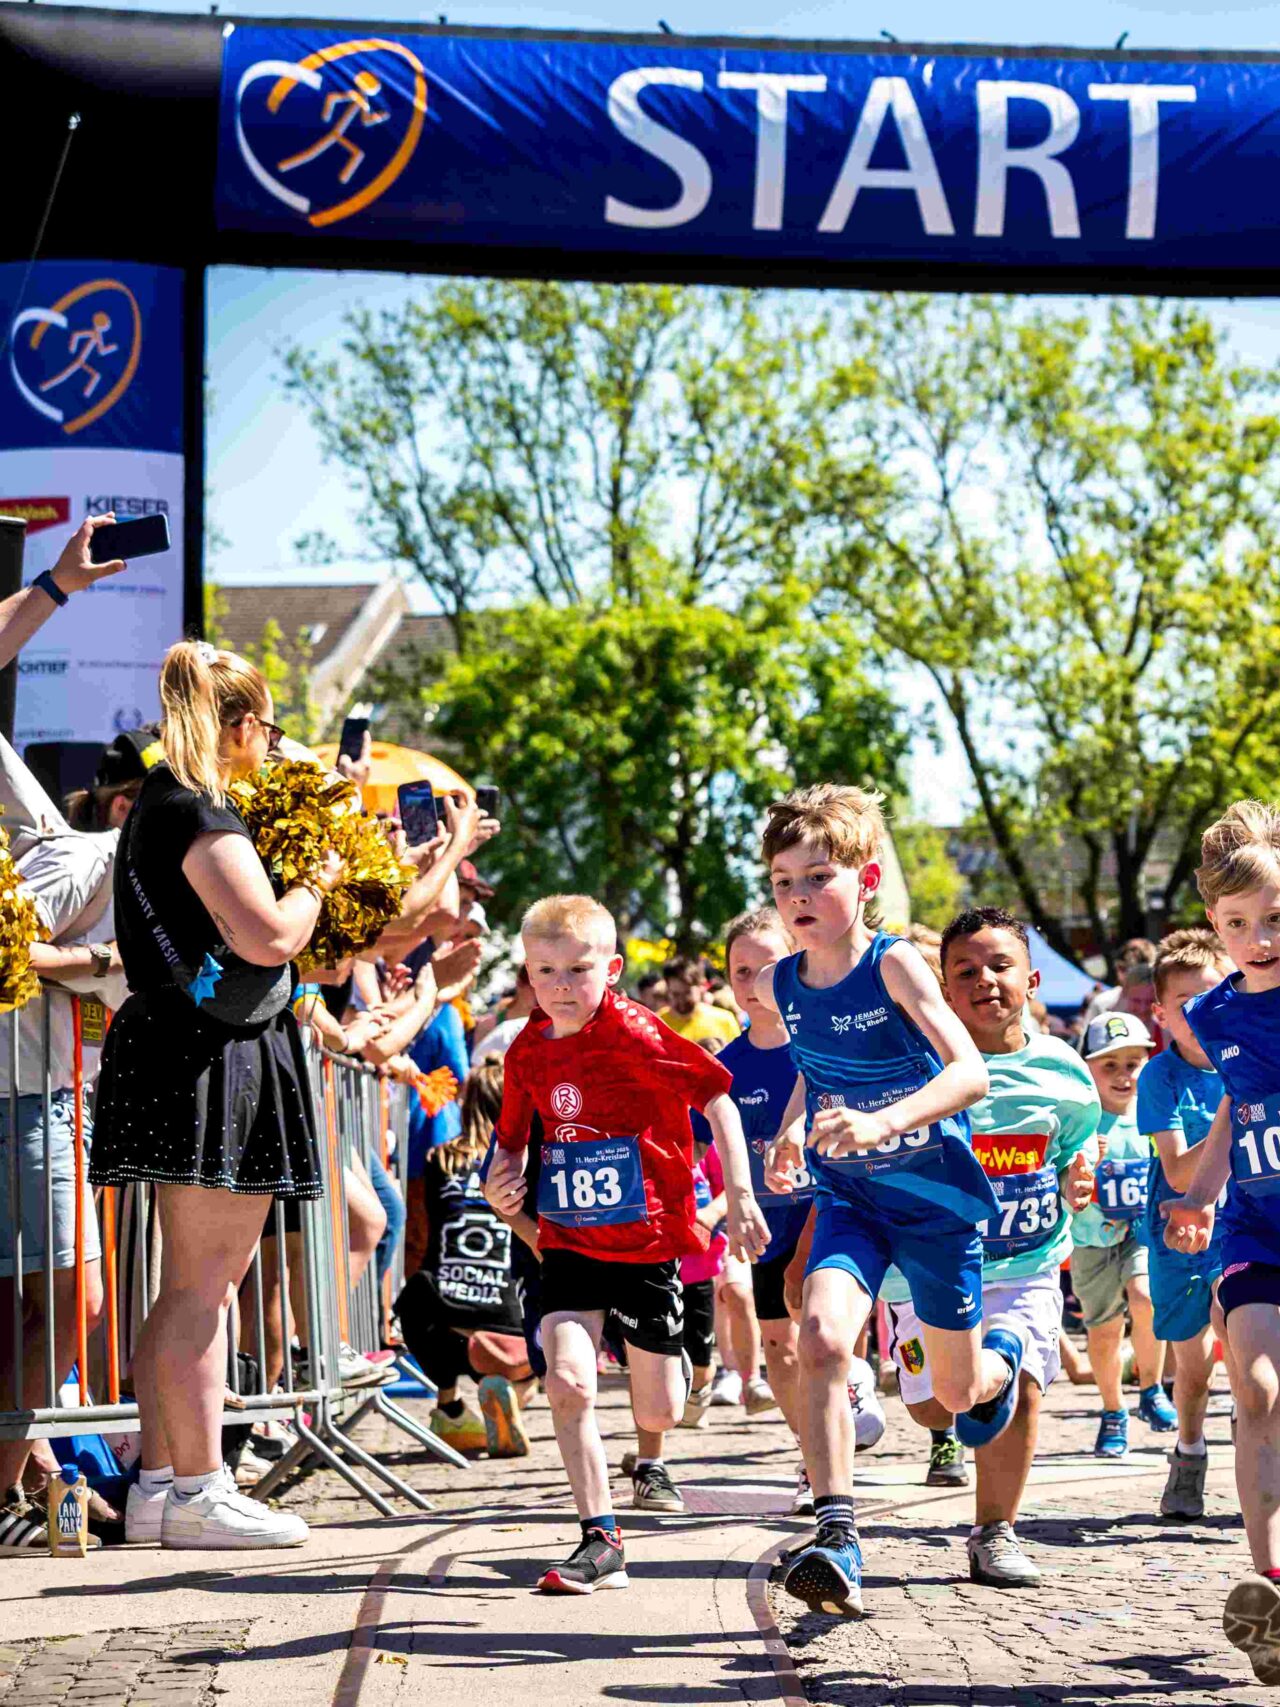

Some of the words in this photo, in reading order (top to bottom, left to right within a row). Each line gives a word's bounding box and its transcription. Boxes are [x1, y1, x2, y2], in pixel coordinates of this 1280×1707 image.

[604, 67, 1197, 239] START
[86, 496, 168, 514] KIESER
[129, 868, 155, 919] VARSITY
[854, 1007, 885, 1021] JEMAKO
[867, 1015, 888, 1027] Rhede
[1221, 1044, 1240, 1061] JAKO
[830, 1094, 845, 1103] 1000
[1249, 1103, 1264, 1112] 1000
[584, 1152, 630, 1163] Herz-Kreislauf
[550, 1166, 622, 1209] 183
[437, 1265, 509, 1288] SOCIAL
[439, 1280, 503, 1305] MEDIA
[58, 1502, 82, 1517] LAND
[58, 1517, 82, 1533] PARK
